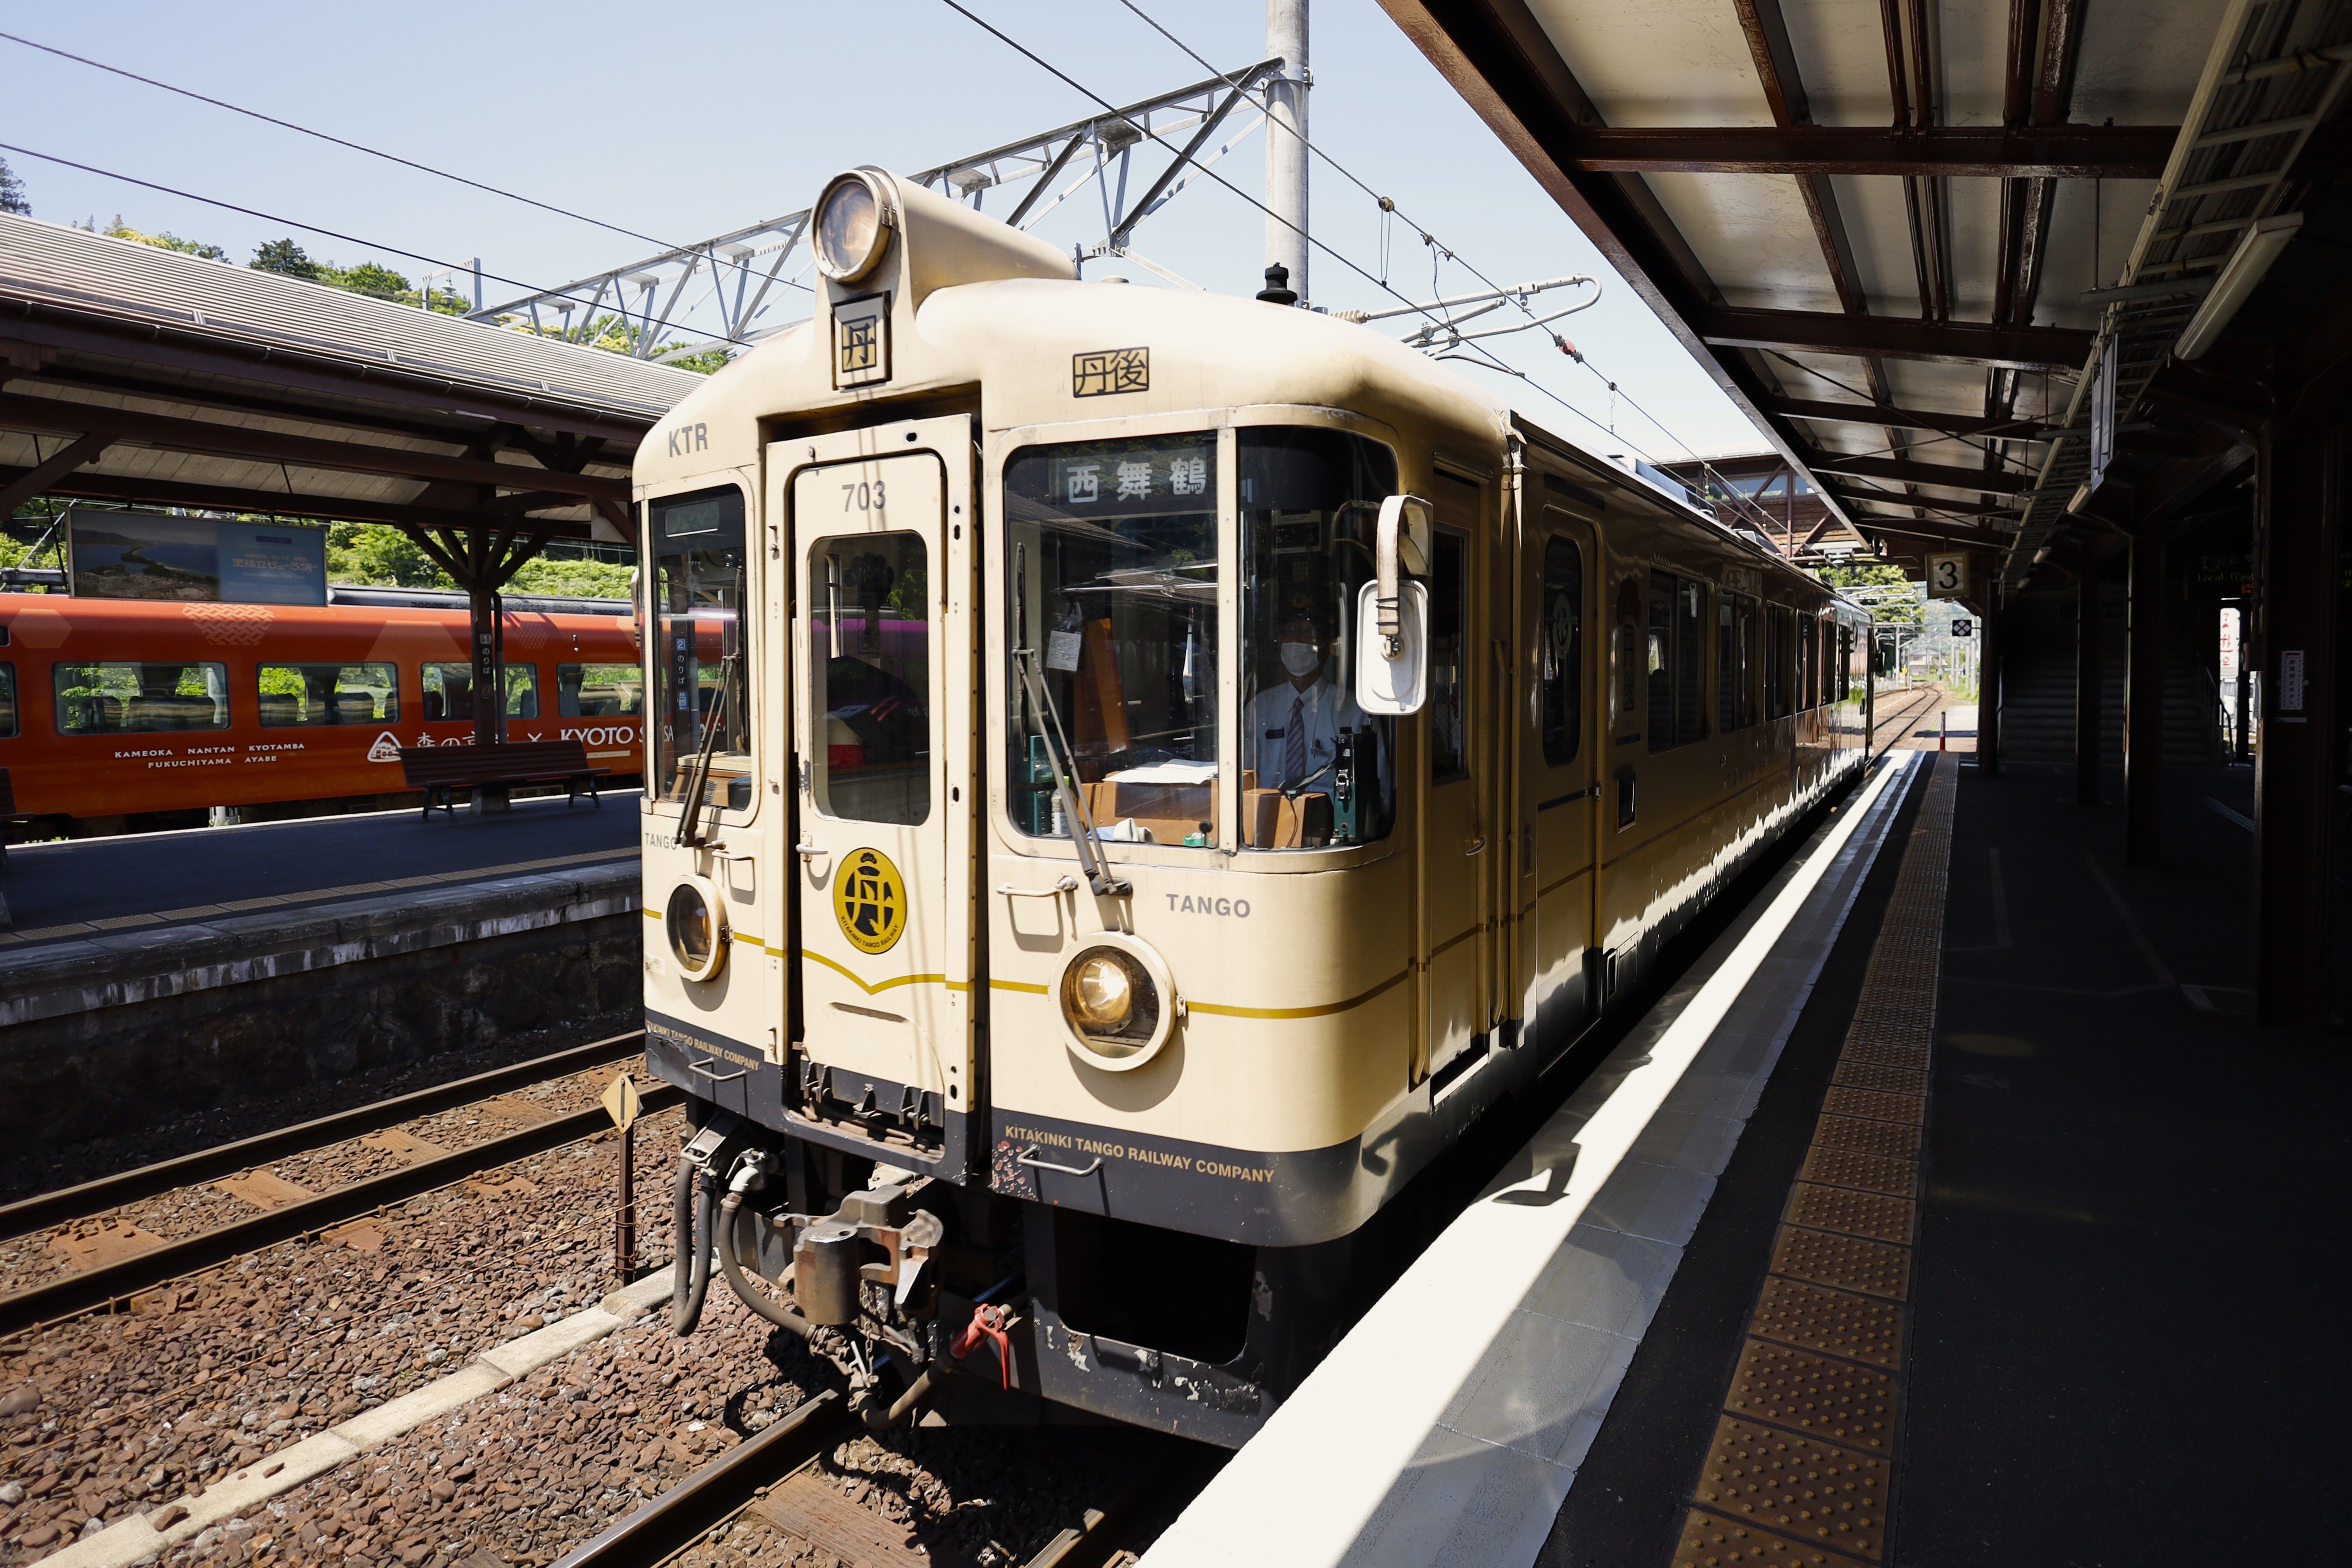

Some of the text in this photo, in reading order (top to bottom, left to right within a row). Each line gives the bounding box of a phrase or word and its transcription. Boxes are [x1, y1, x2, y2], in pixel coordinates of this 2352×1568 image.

[1074, 348, 1149, 397] 丹後
[669, 422, 708, 457] KTR
[1067, 457, 1207, 503] 西舞鶴
[842, 480, 886, 512] 703
[1938, 561, 1958, 589] 3
[482, 648, 490, 674] のりば
[677, 655, 685, 685] のりば
[114, 742, 304, 758] KAMEOKA NANTAN KYOTAMBA
[560, 726, 634, 746] KYOTO
[147, 755, 277, 768] FUKUCHIYAMA AYABE
[644, 833, 677, 850] TANGO
[1166, 894, 1251, 918] TANGO
[880, 923, 898, 946] RAILWAY
[694, 1039, 723, 1058] RAILWAY
[724, 1050, 759, 1071] COMPANY
[1005, 1126, 1275, 1183] KITAKINKI TANGO RAILWAY COMPANY
